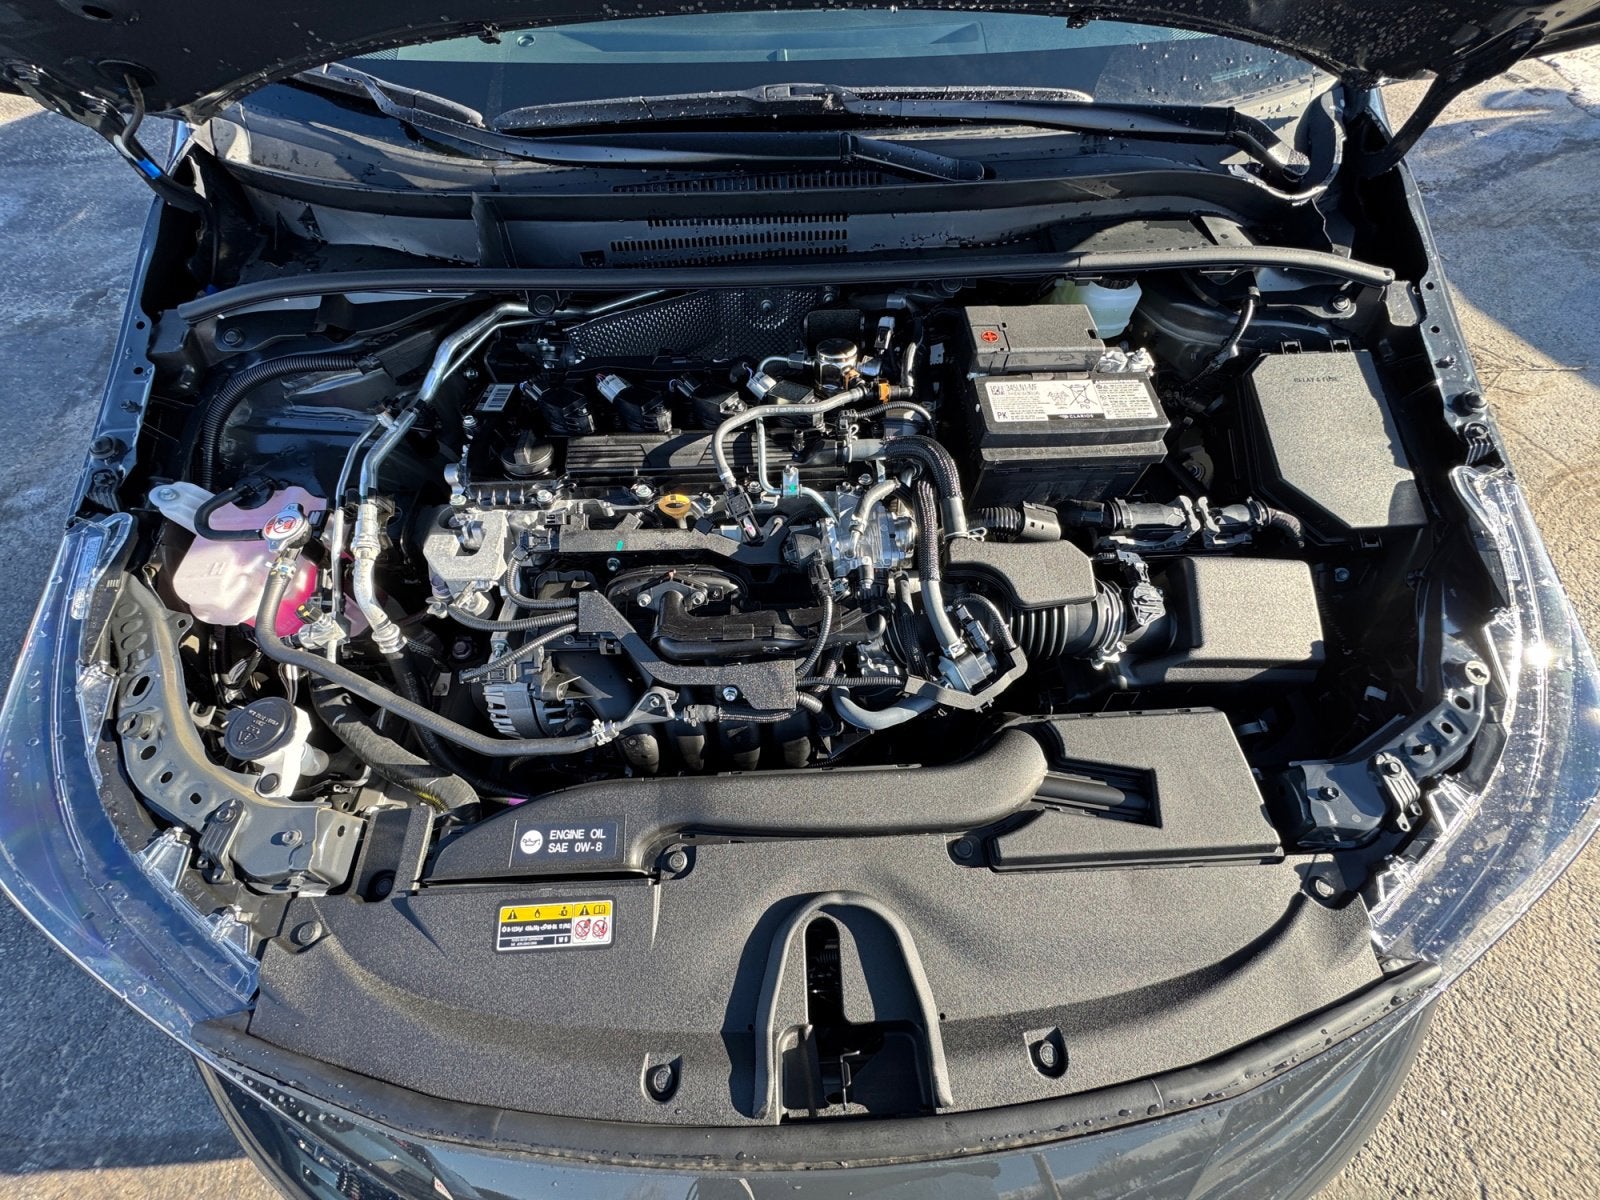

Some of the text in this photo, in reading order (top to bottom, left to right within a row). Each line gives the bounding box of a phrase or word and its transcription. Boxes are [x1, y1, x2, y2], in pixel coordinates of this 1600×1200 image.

[997, 411, 1008, 419] PK
[549, 828, 606, 840] ENGINE OIL
[548, 841, 603, 853] SAE 0W-8
